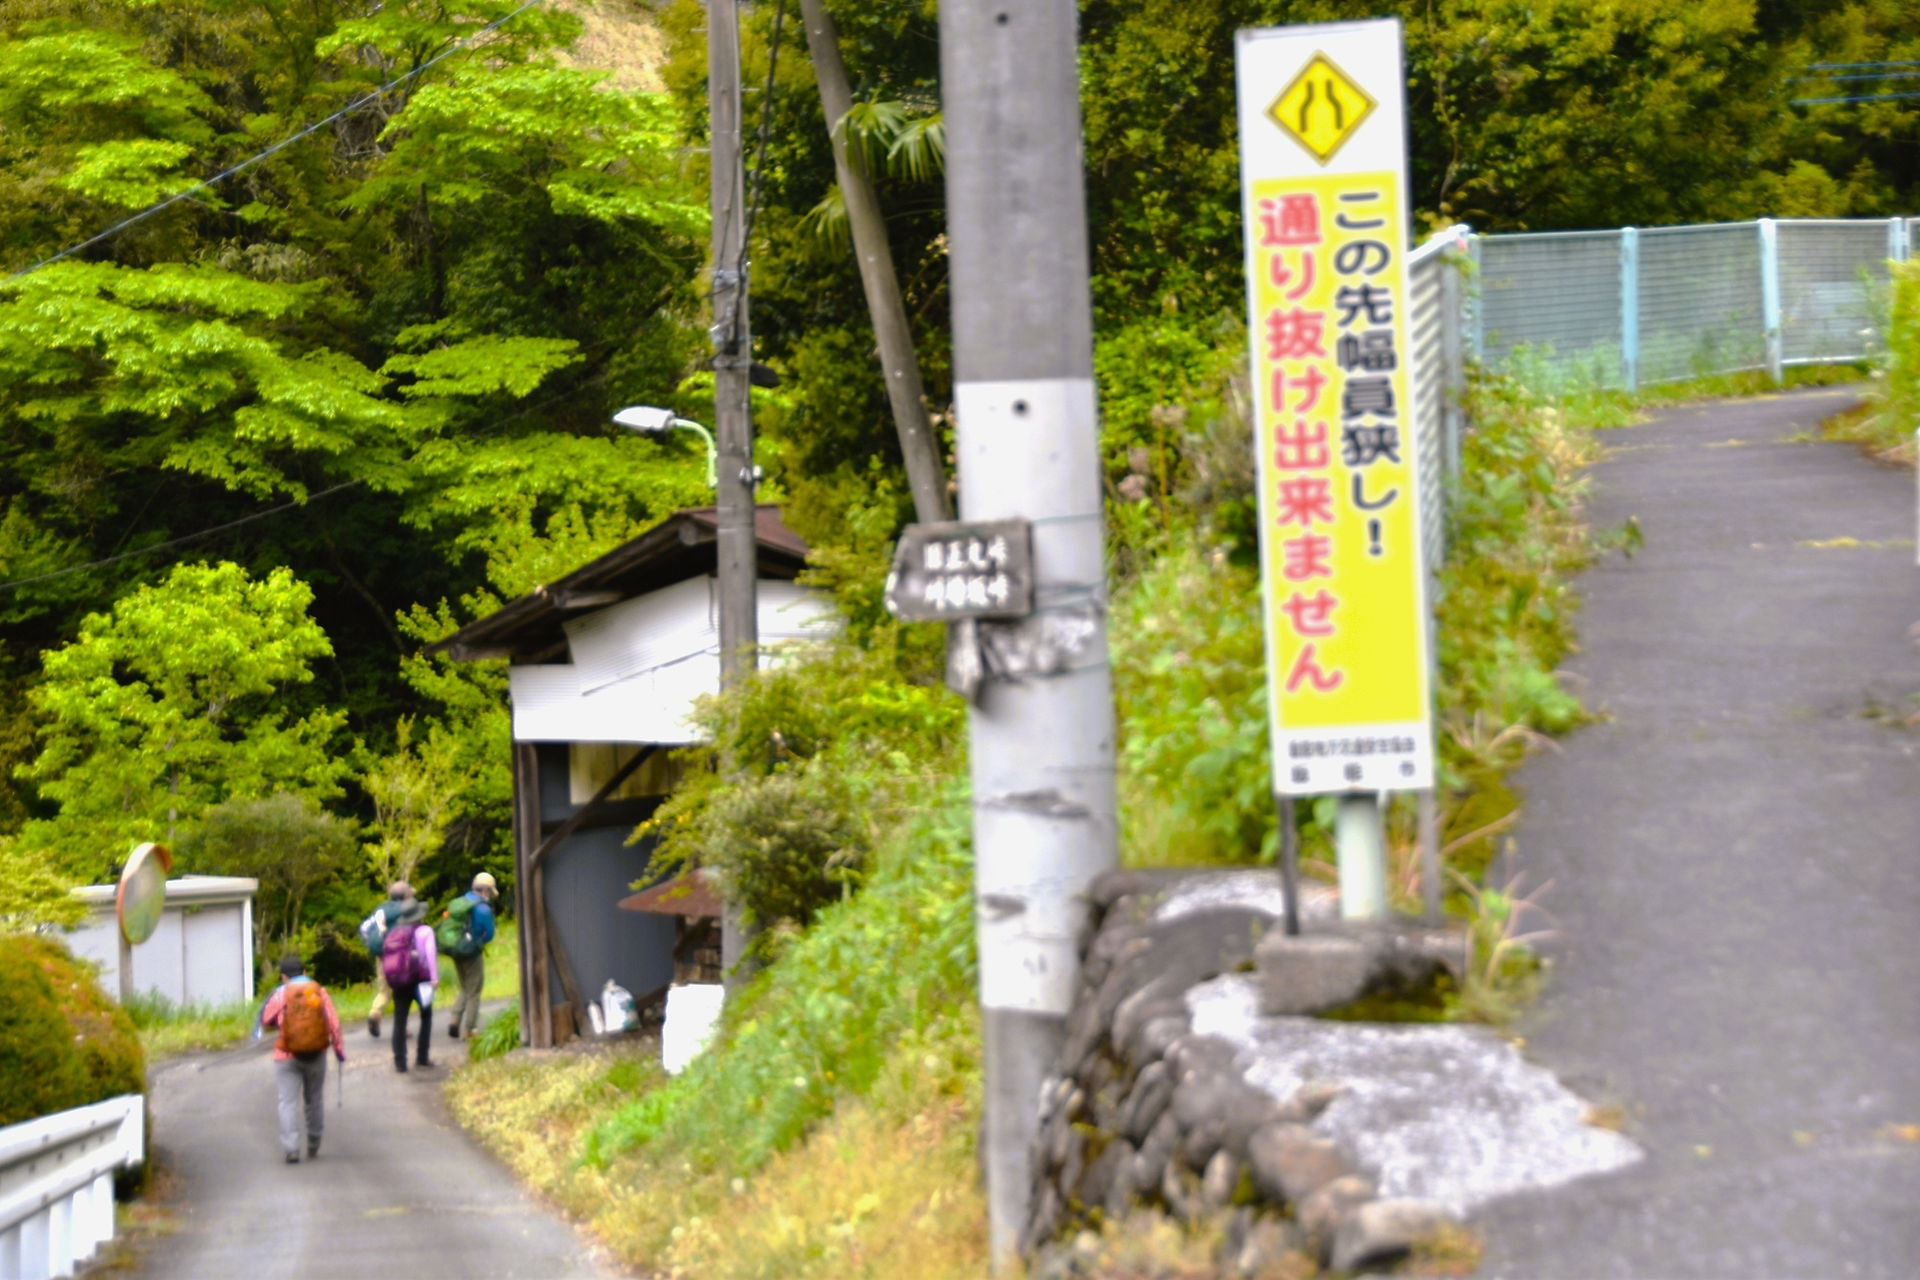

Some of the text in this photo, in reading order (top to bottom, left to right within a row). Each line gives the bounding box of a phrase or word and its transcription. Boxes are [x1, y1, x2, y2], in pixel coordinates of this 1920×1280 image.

[1261, 193, 1343, 691] 通り抜け出来ません
[1335, 191, 1399, 558] この先幅員狭し！
